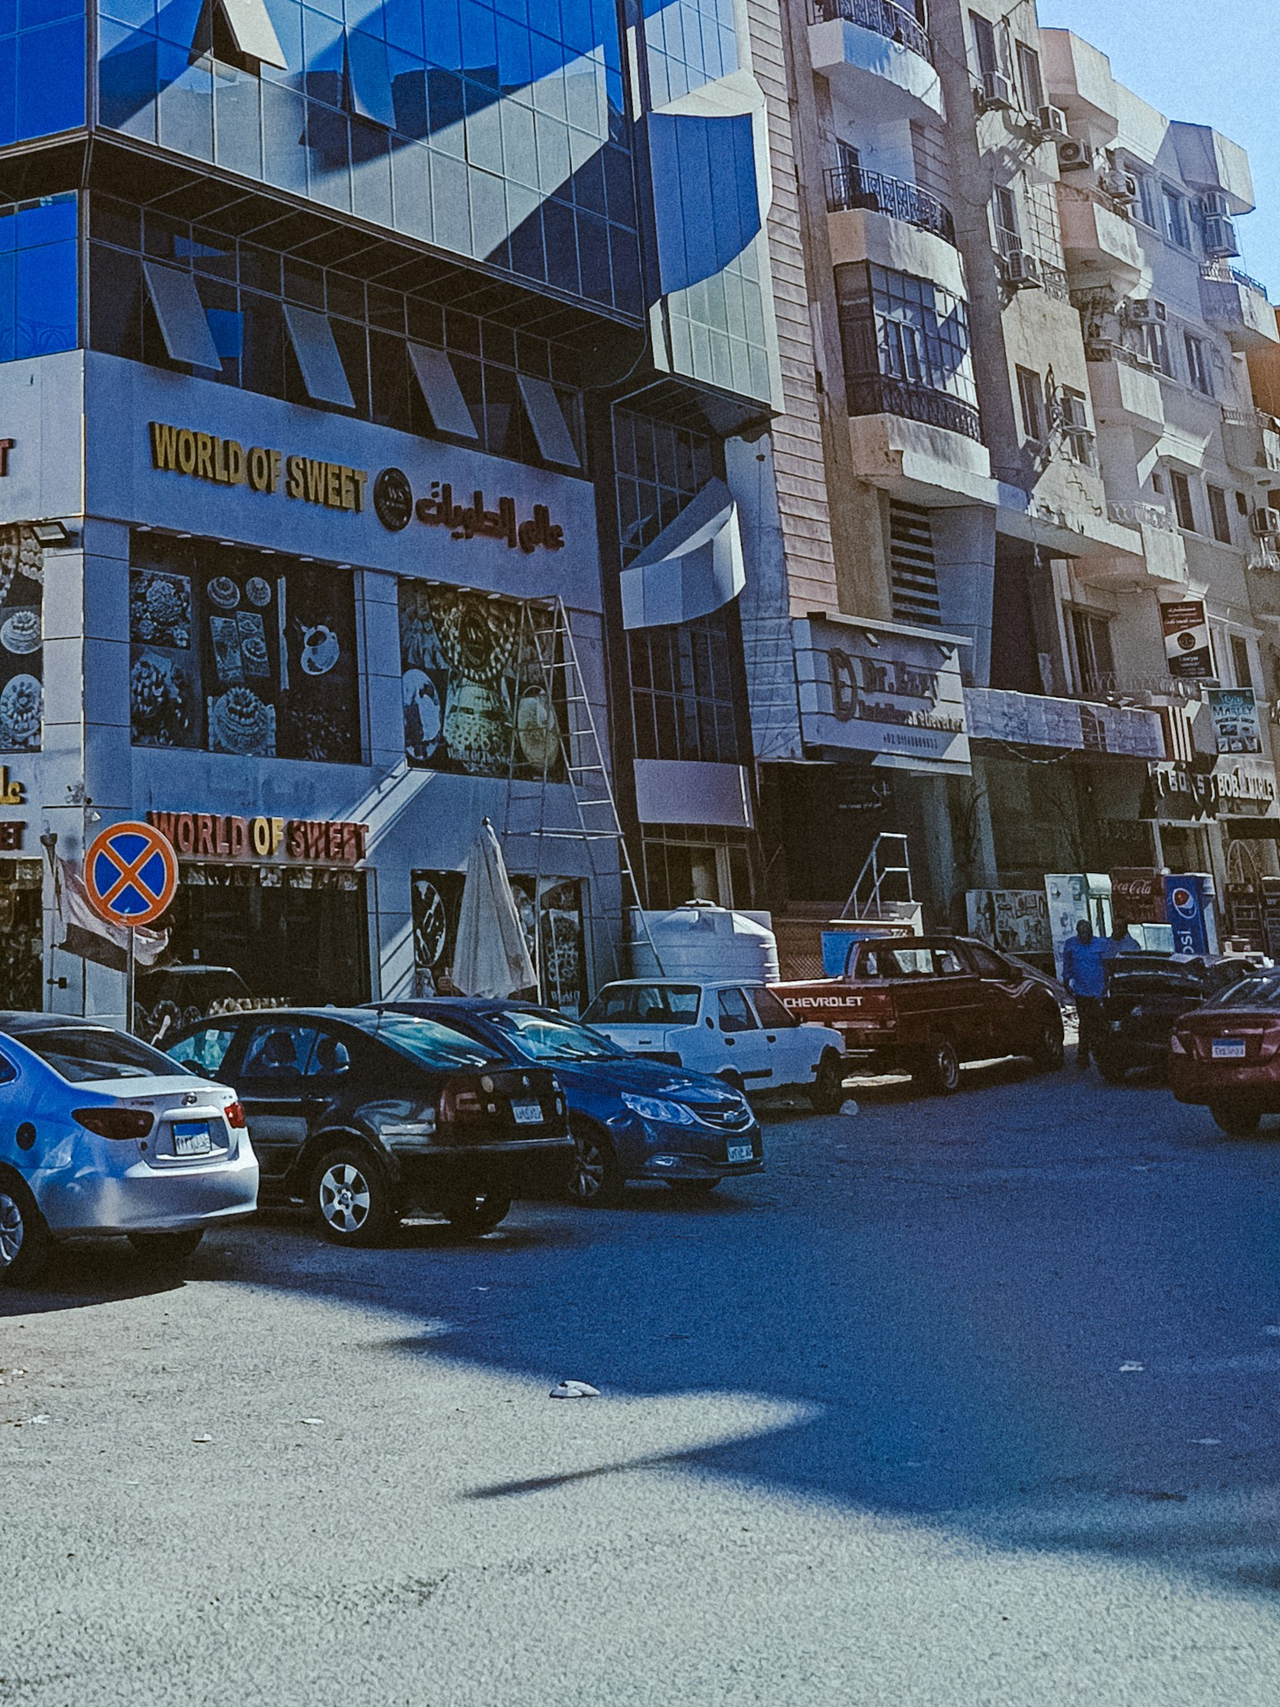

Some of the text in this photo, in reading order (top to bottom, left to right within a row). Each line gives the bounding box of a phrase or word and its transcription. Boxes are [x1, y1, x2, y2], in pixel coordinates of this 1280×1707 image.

[149, 421, 368, 513] WORLD OF SWEET
[415, 481, 565, 555] عالم الحلويات
[1212, 706, 1254, 717] MARLEY
[1217, 773, 1240, 798] BOB
[146, 810, 370, 863] WORLD OF SWEET
[783, 996, 863, 1008] CHEVROLET
